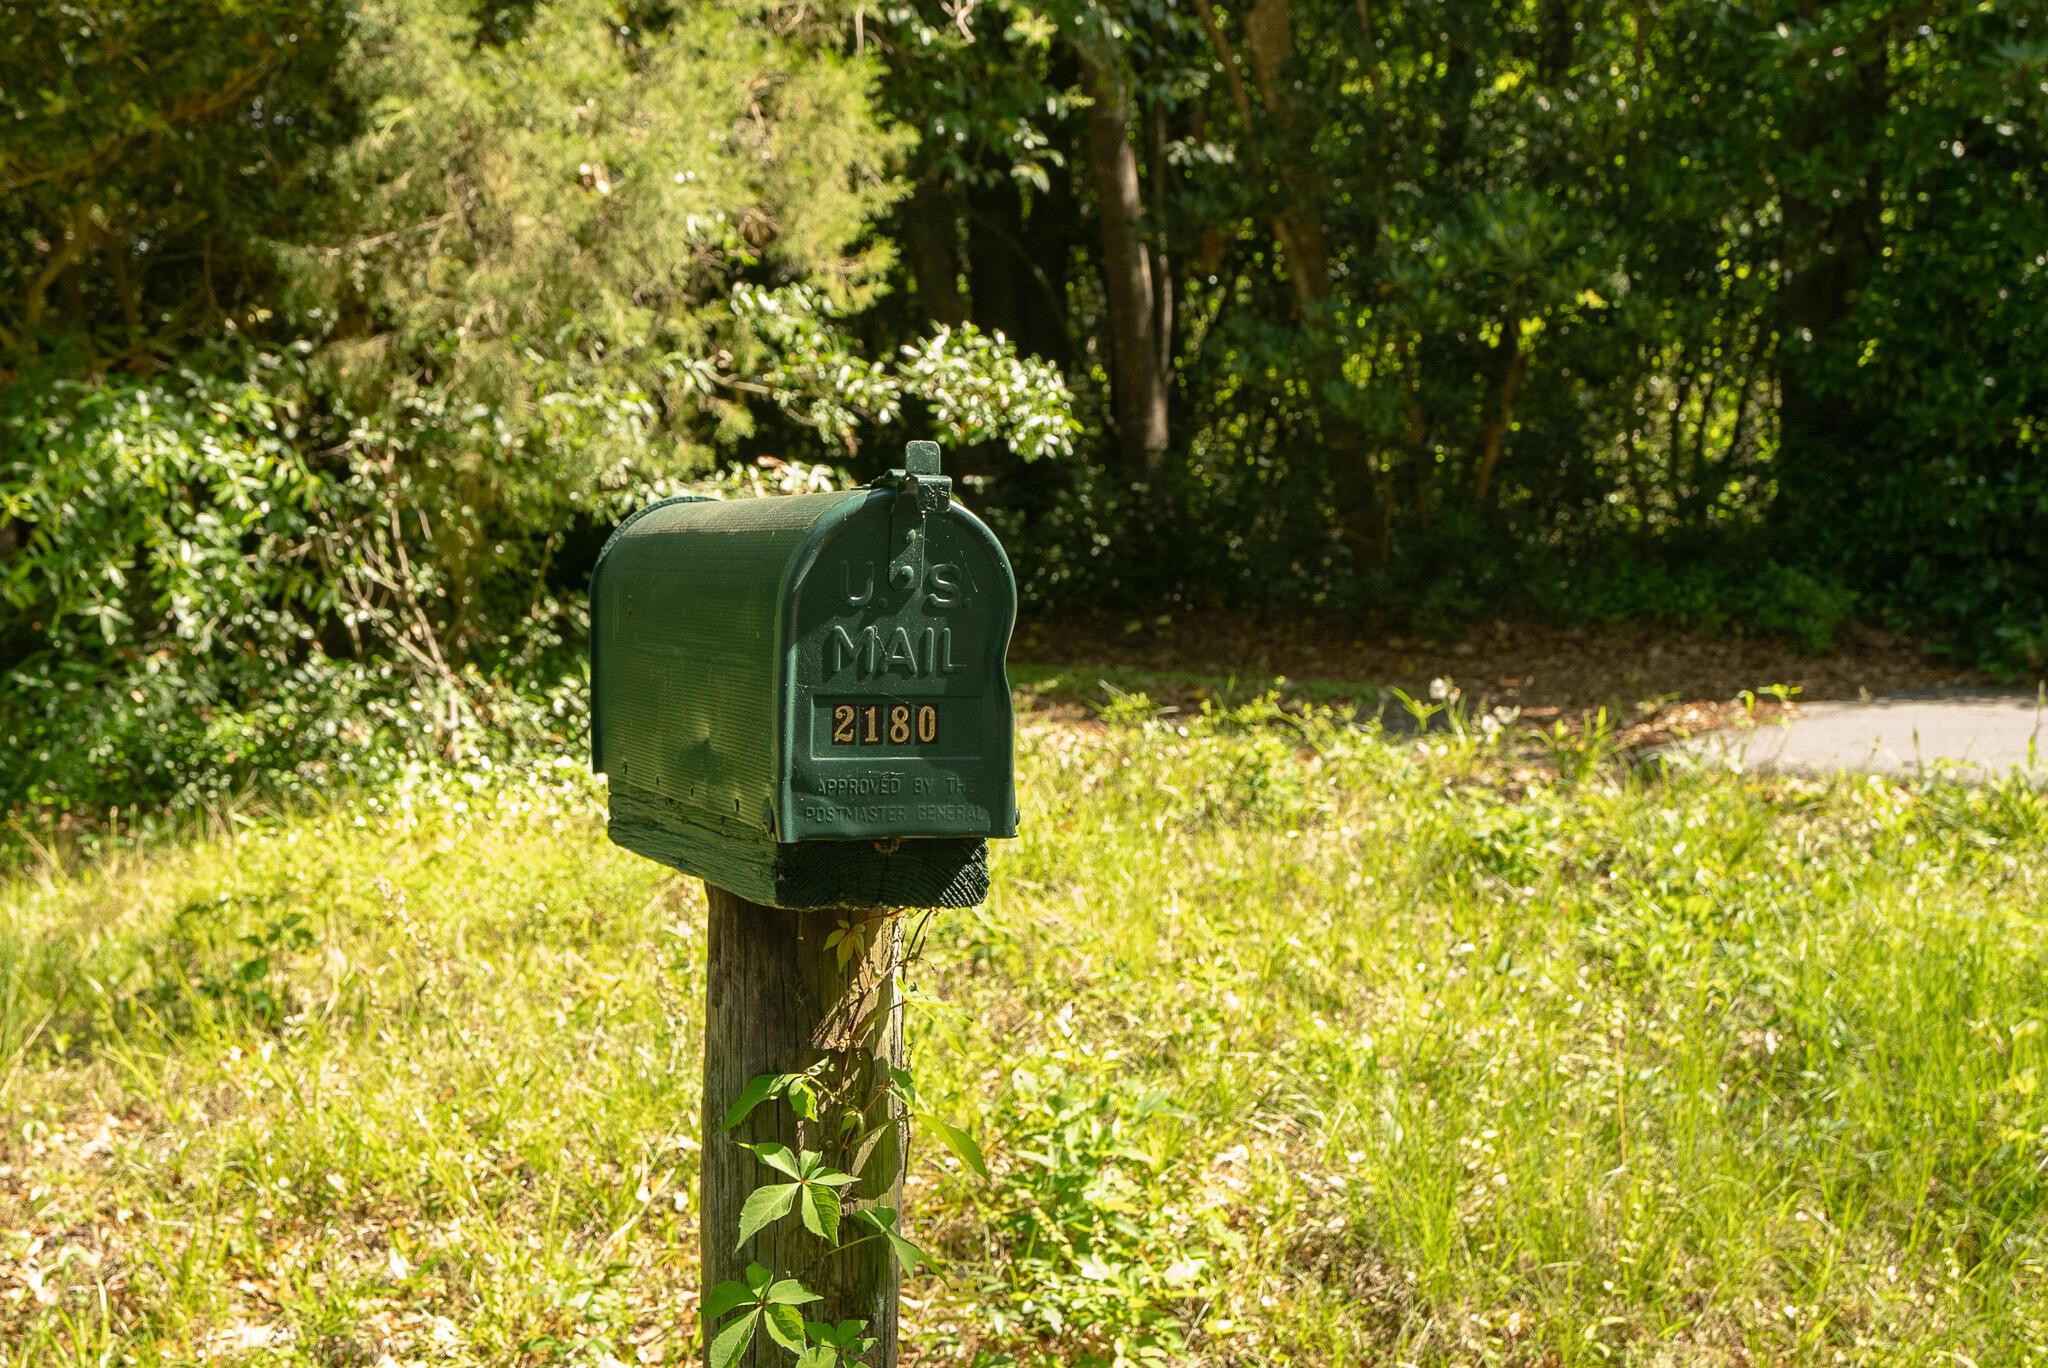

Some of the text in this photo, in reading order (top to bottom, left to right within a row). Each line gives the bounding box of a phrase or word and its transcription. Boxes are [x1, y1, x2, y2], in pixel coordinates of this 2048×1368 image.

[831, 625, 968, 674] MAIL
[833, 704, 937, 743] 2180
[817, 776, 976, 796] APPROVED BY THE
[804, 803, 986, 824] POSTMASTER GENERAL
